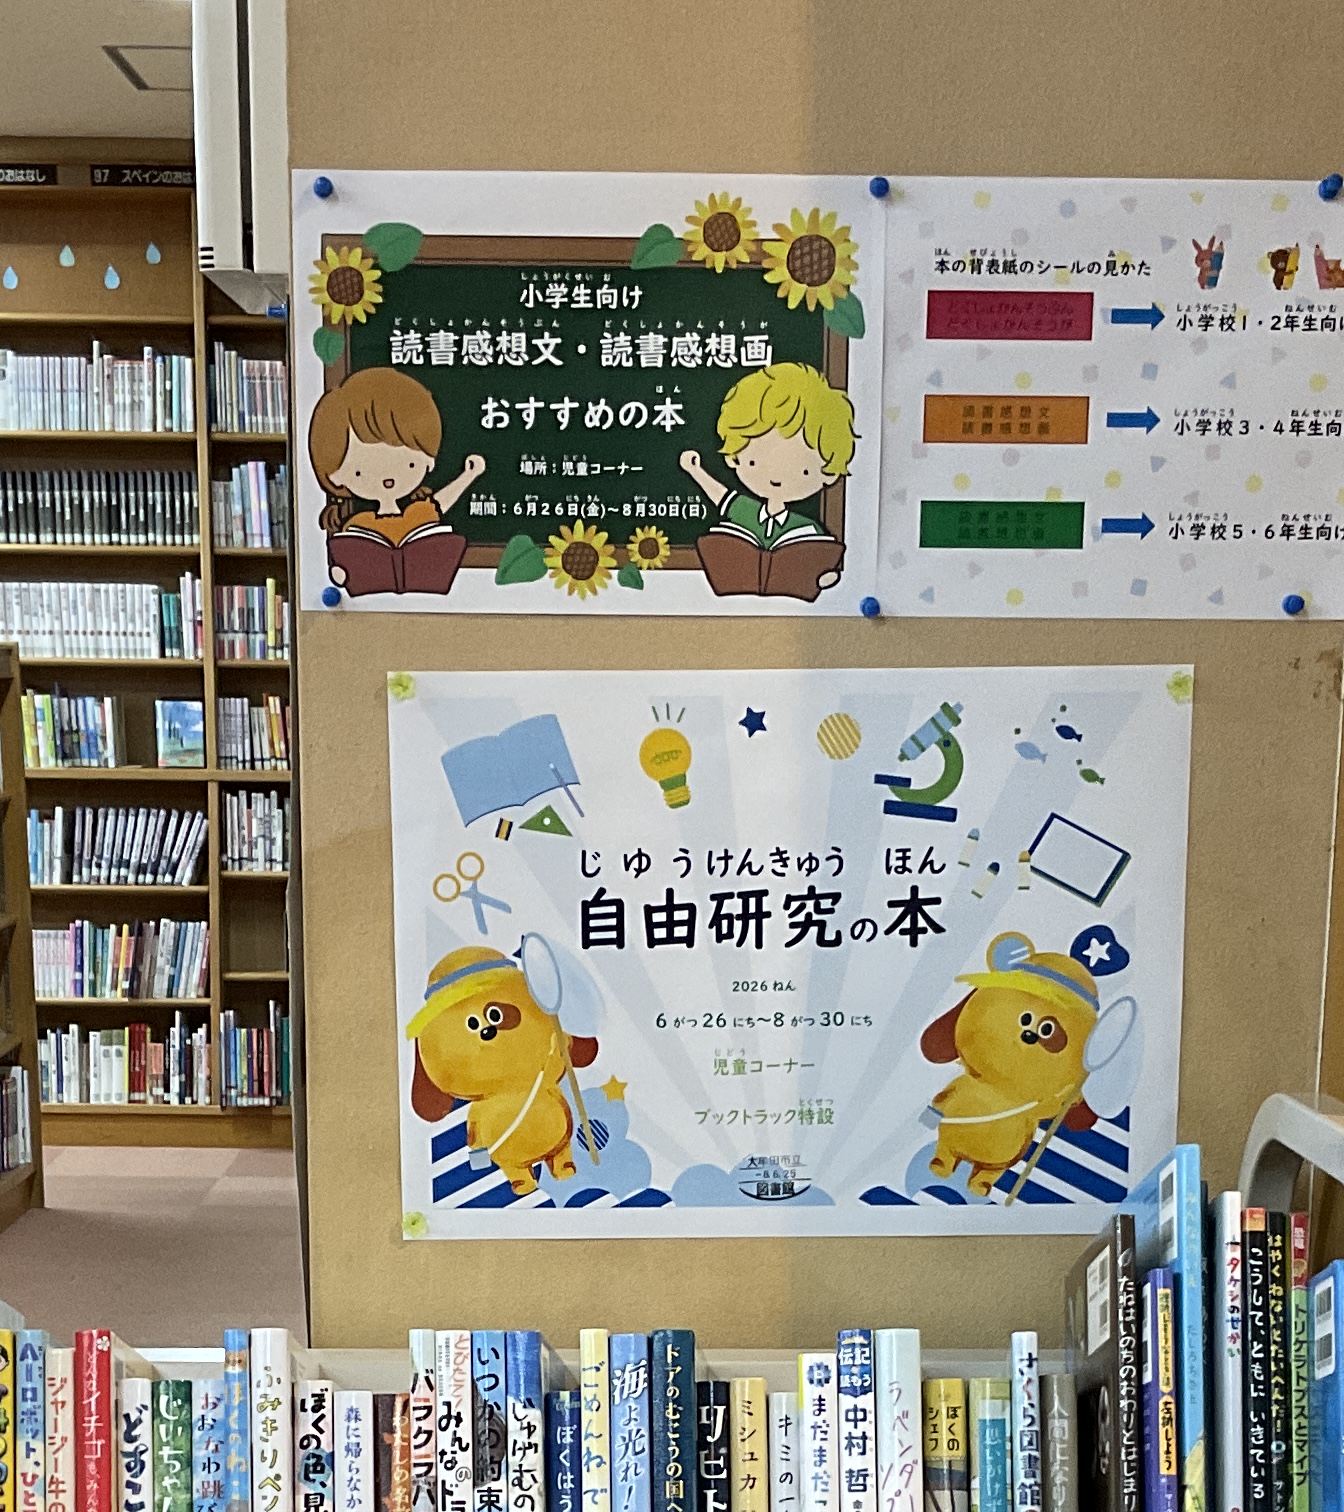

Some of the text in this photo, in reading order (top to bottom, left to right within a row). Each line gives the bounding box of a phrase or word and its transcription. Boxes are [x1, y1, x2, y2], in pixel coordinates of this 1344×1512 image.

[934, 258, 1152, 277] 本の背表紙のシールの見かた
[520, 283, 643, 310] 小学生向け
[389, 330, 773, 368] 読書感想文・読書感想画
[480, 396, 685, 432] おすすめの本
[579, 846, 947, 880] じゆう けんきゅう ほん
[579, 885, 947, 951] 自由研究の本
[732, 980, 796, 993] 2026 ねん
[656, 1013, 667, 1028] 6
[674, 1015, 697, 1027] がつ
[703, 1012, 727, 1028] 26
[791, 1015, 814, 1026] がつ
[819, 1011, 845, 1027] 30
[850, 1014, 873, 1026] にち
[713, 1058, 815, 1076] 児童コーナー
[695, 1107, 834, 1126] ブックトラック特設
[838, 1348, 871, 1365] 伝記
[1250, 1248, 1266, 1499] こうして、ともにいきている
[1118, 1277, 1137, 1512] たねはいのちのおわりとはじまり
[611, 1359, 649, 1509] 海よ光れ!
[739, 1400, 759, 1492] ミシュカ
[928, 1405, 940, 1452] シェフ
[947, 1405, 960, 1452] ぼくの
[844, 1404, 868, 1493] 中村哲
